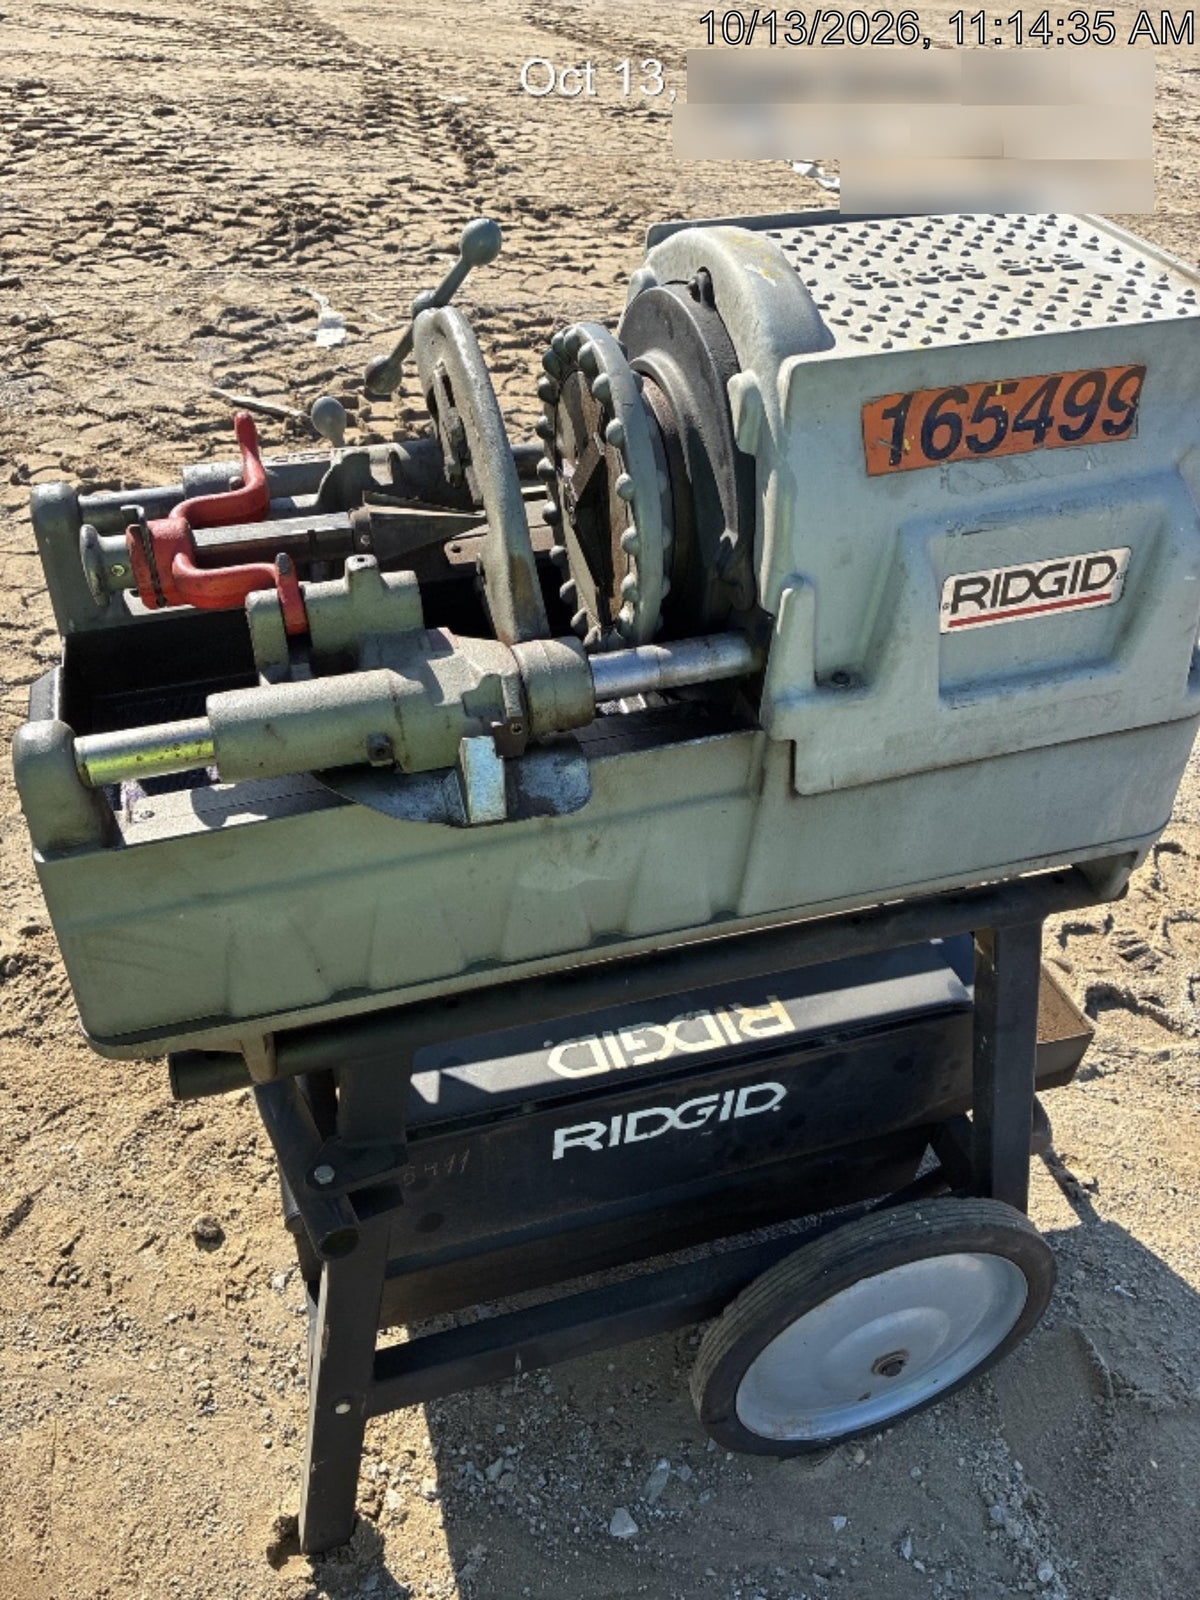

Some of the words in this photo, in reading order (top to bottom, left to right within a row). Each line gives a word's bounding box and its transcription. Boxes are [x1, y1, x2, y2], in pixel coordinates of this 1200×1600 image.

[881, 367, 1146, 466] 165499
[951, 556, 1118, 615] RIDGID
[547, 996, 796, 1079] RIDGID
[552, 1082, 788, 1160] RIDGID
